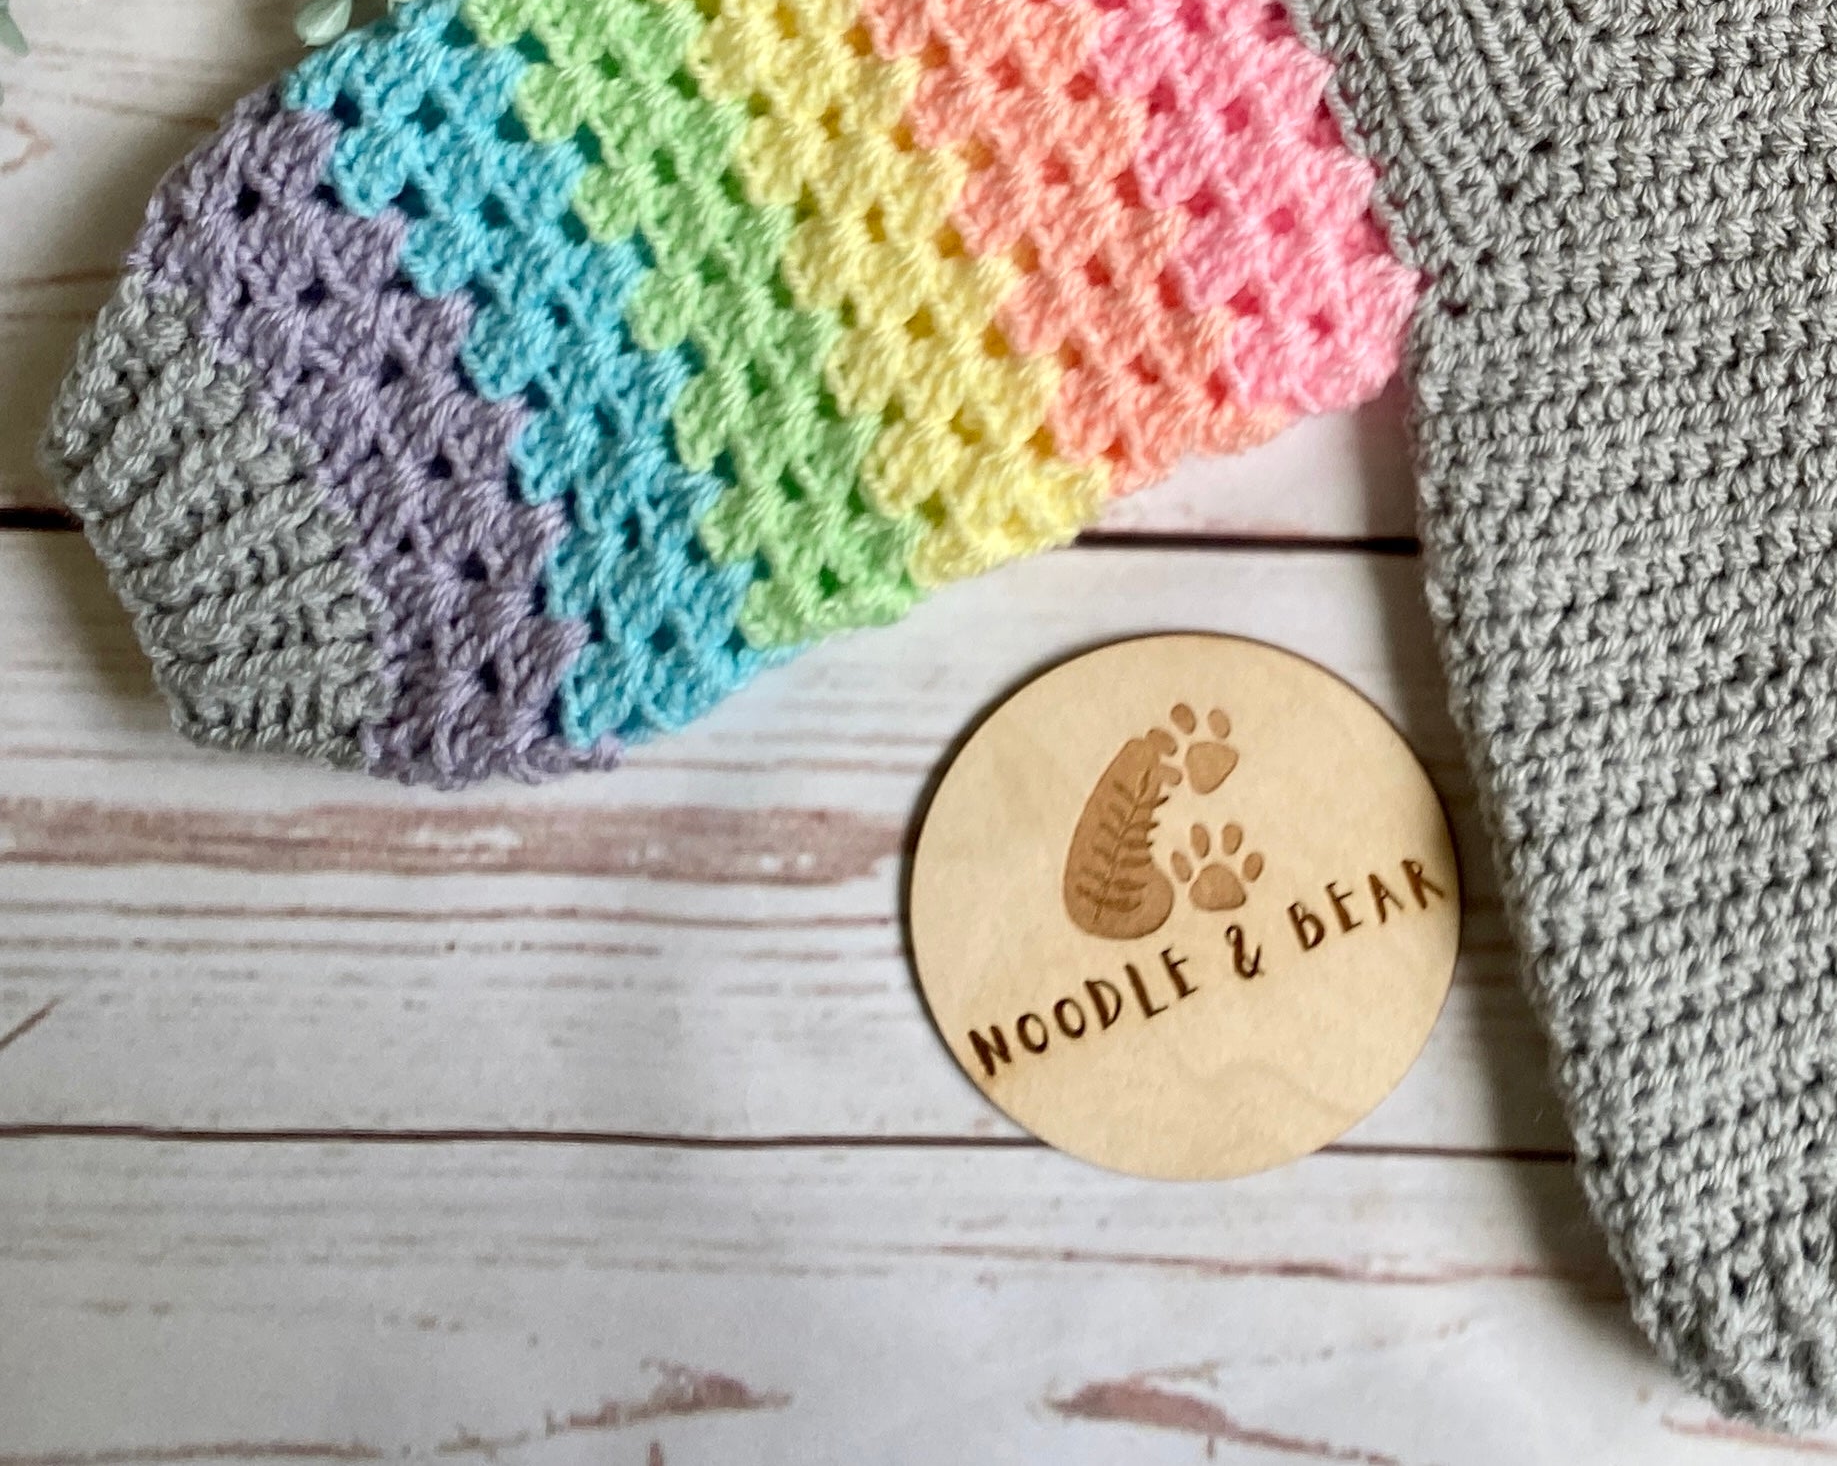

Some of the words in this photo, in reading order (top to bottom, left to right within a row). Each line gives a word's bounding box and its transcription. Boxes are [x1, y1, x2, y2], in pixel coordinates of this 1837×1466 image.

[967, 947, 1198, 1077] NOODLE
[1224, 924, 1265, 981] &
[1286, 858, 1445, 953] BEAR
